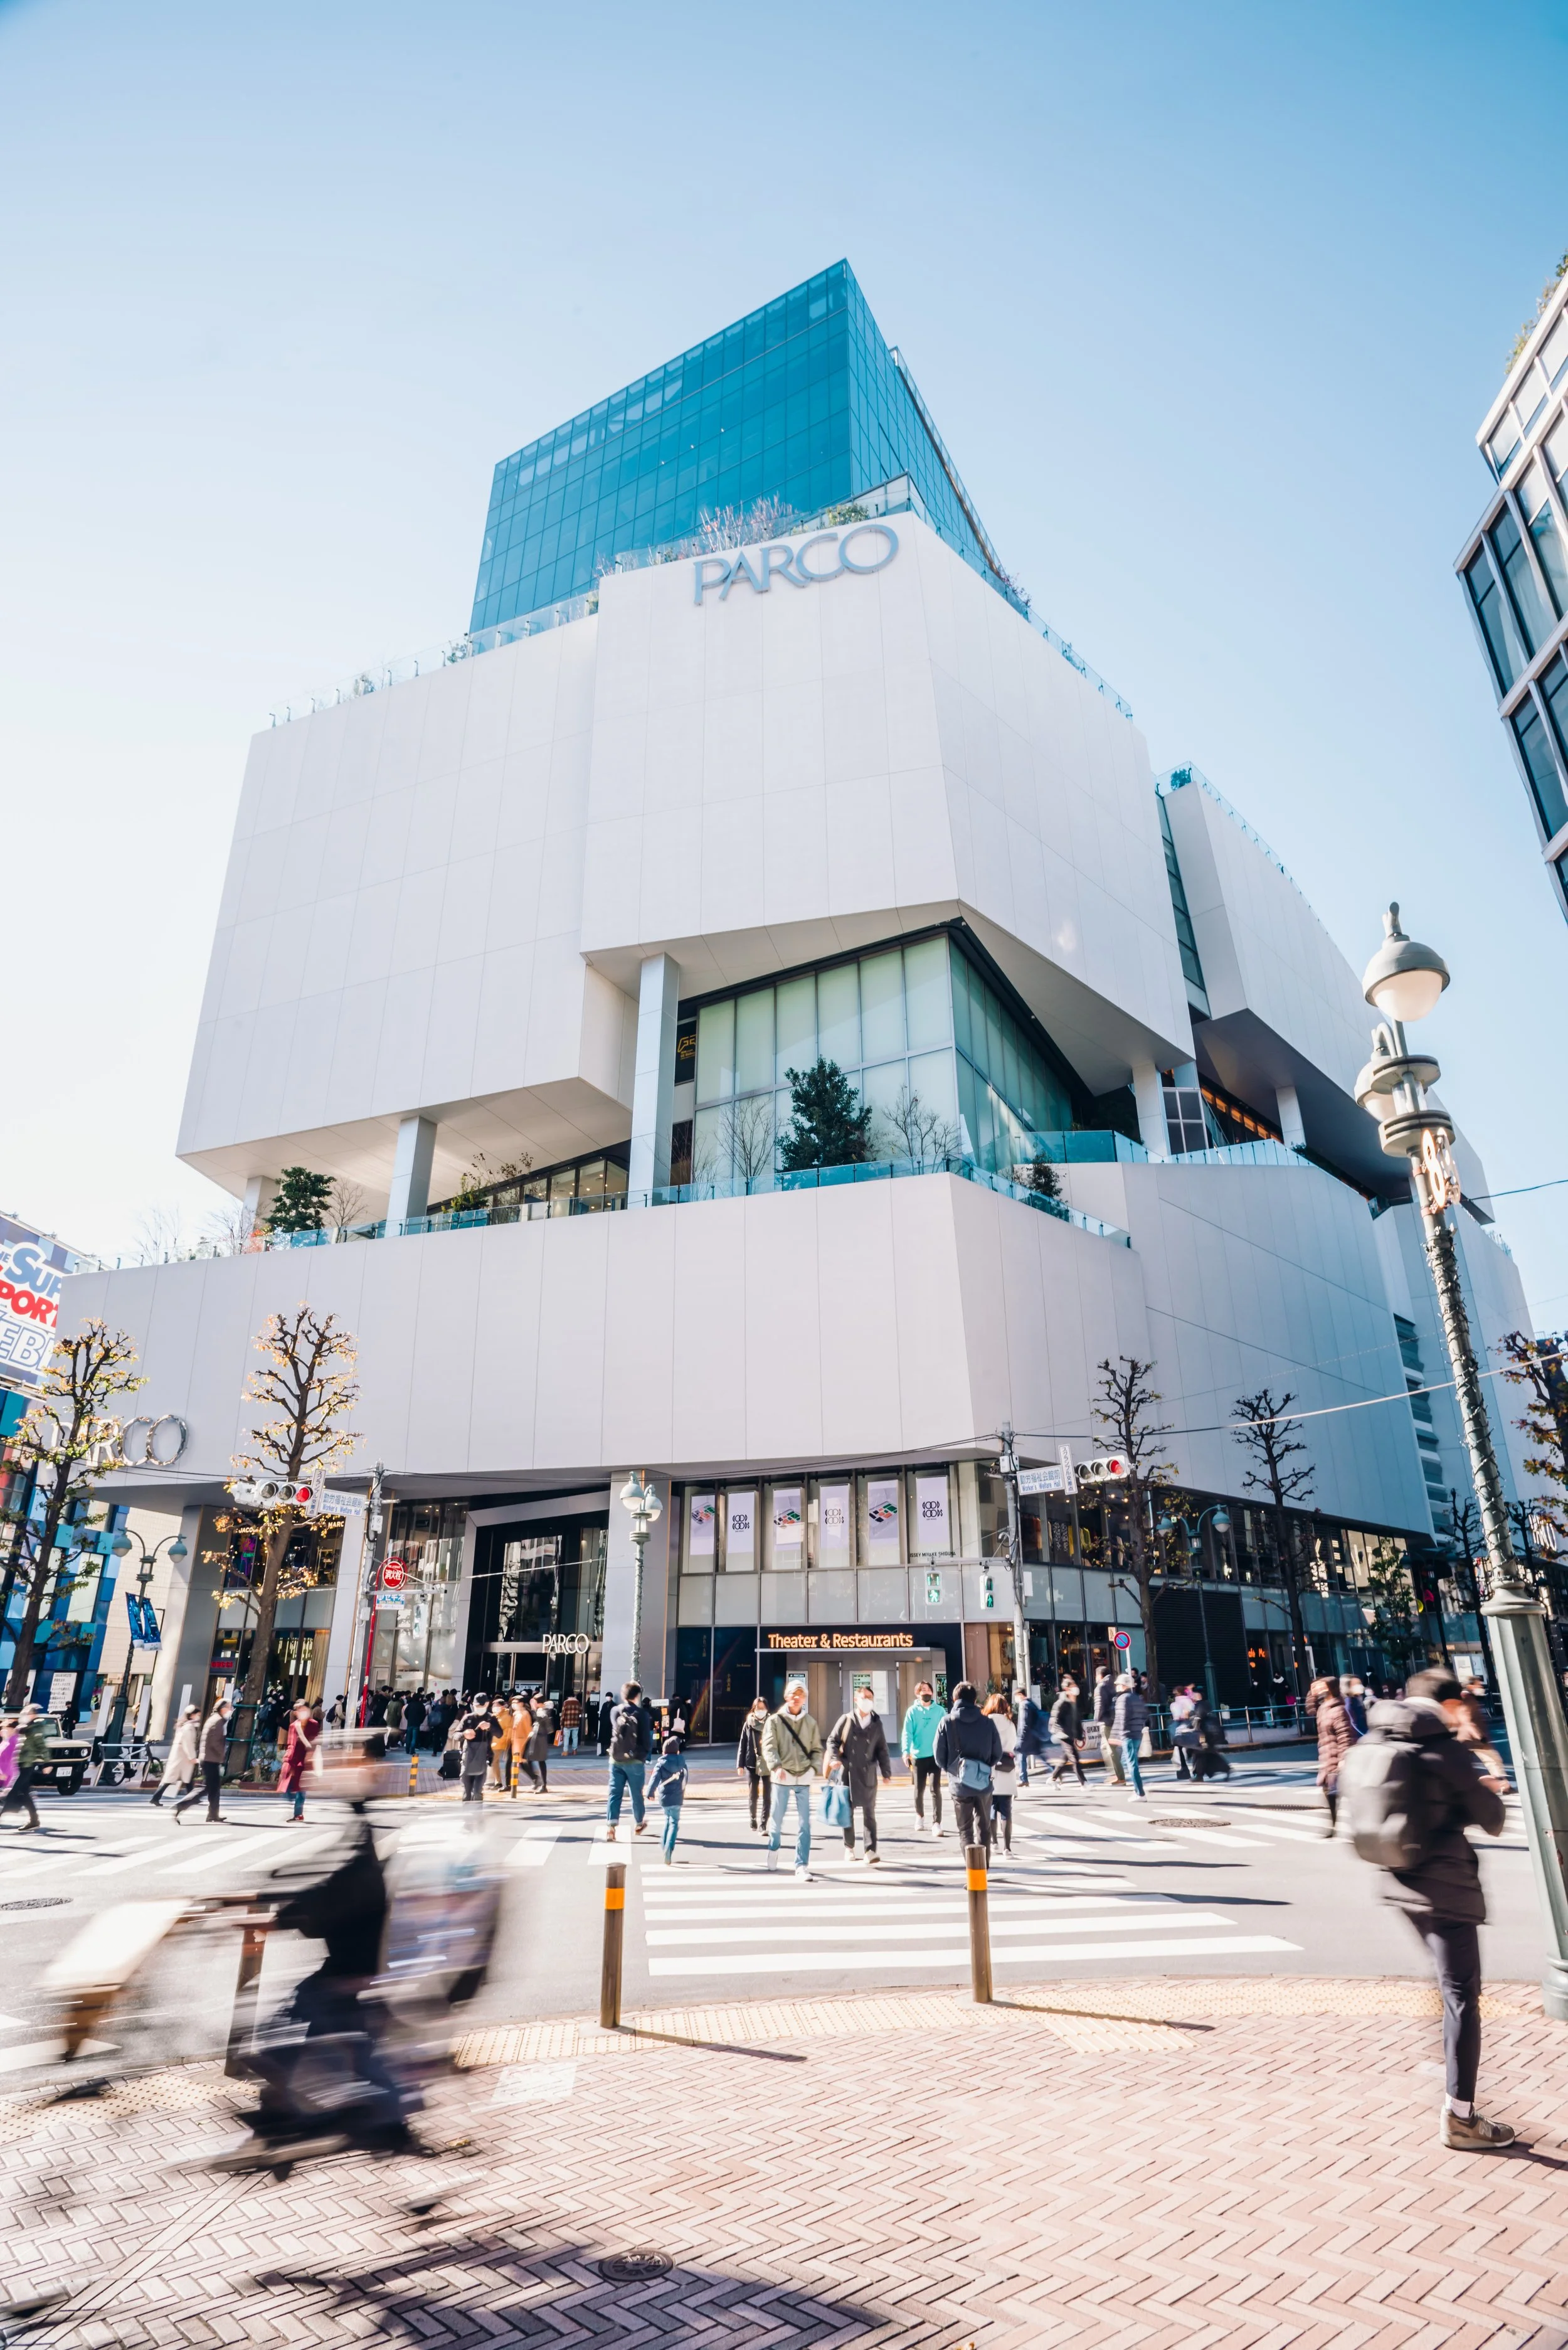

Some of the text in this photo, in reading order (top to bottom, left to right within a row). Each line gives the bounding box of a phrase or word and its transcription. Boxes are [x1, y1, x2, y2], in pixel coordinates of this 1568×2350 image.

[693, 524, 899, 606] PARCO
[0, 1264, 58, 1327] POR
[1020, 1470, 1061, 1484] 勤労福祉会館前
[323, 1493, 363, 1507] 勤労福祉会館前
[384, 1569, 402, 1580] 消火栓
[542, 1633, 589, 1655] PARCO
[768, 1632, 914, 1649] Theater & Restaurants
